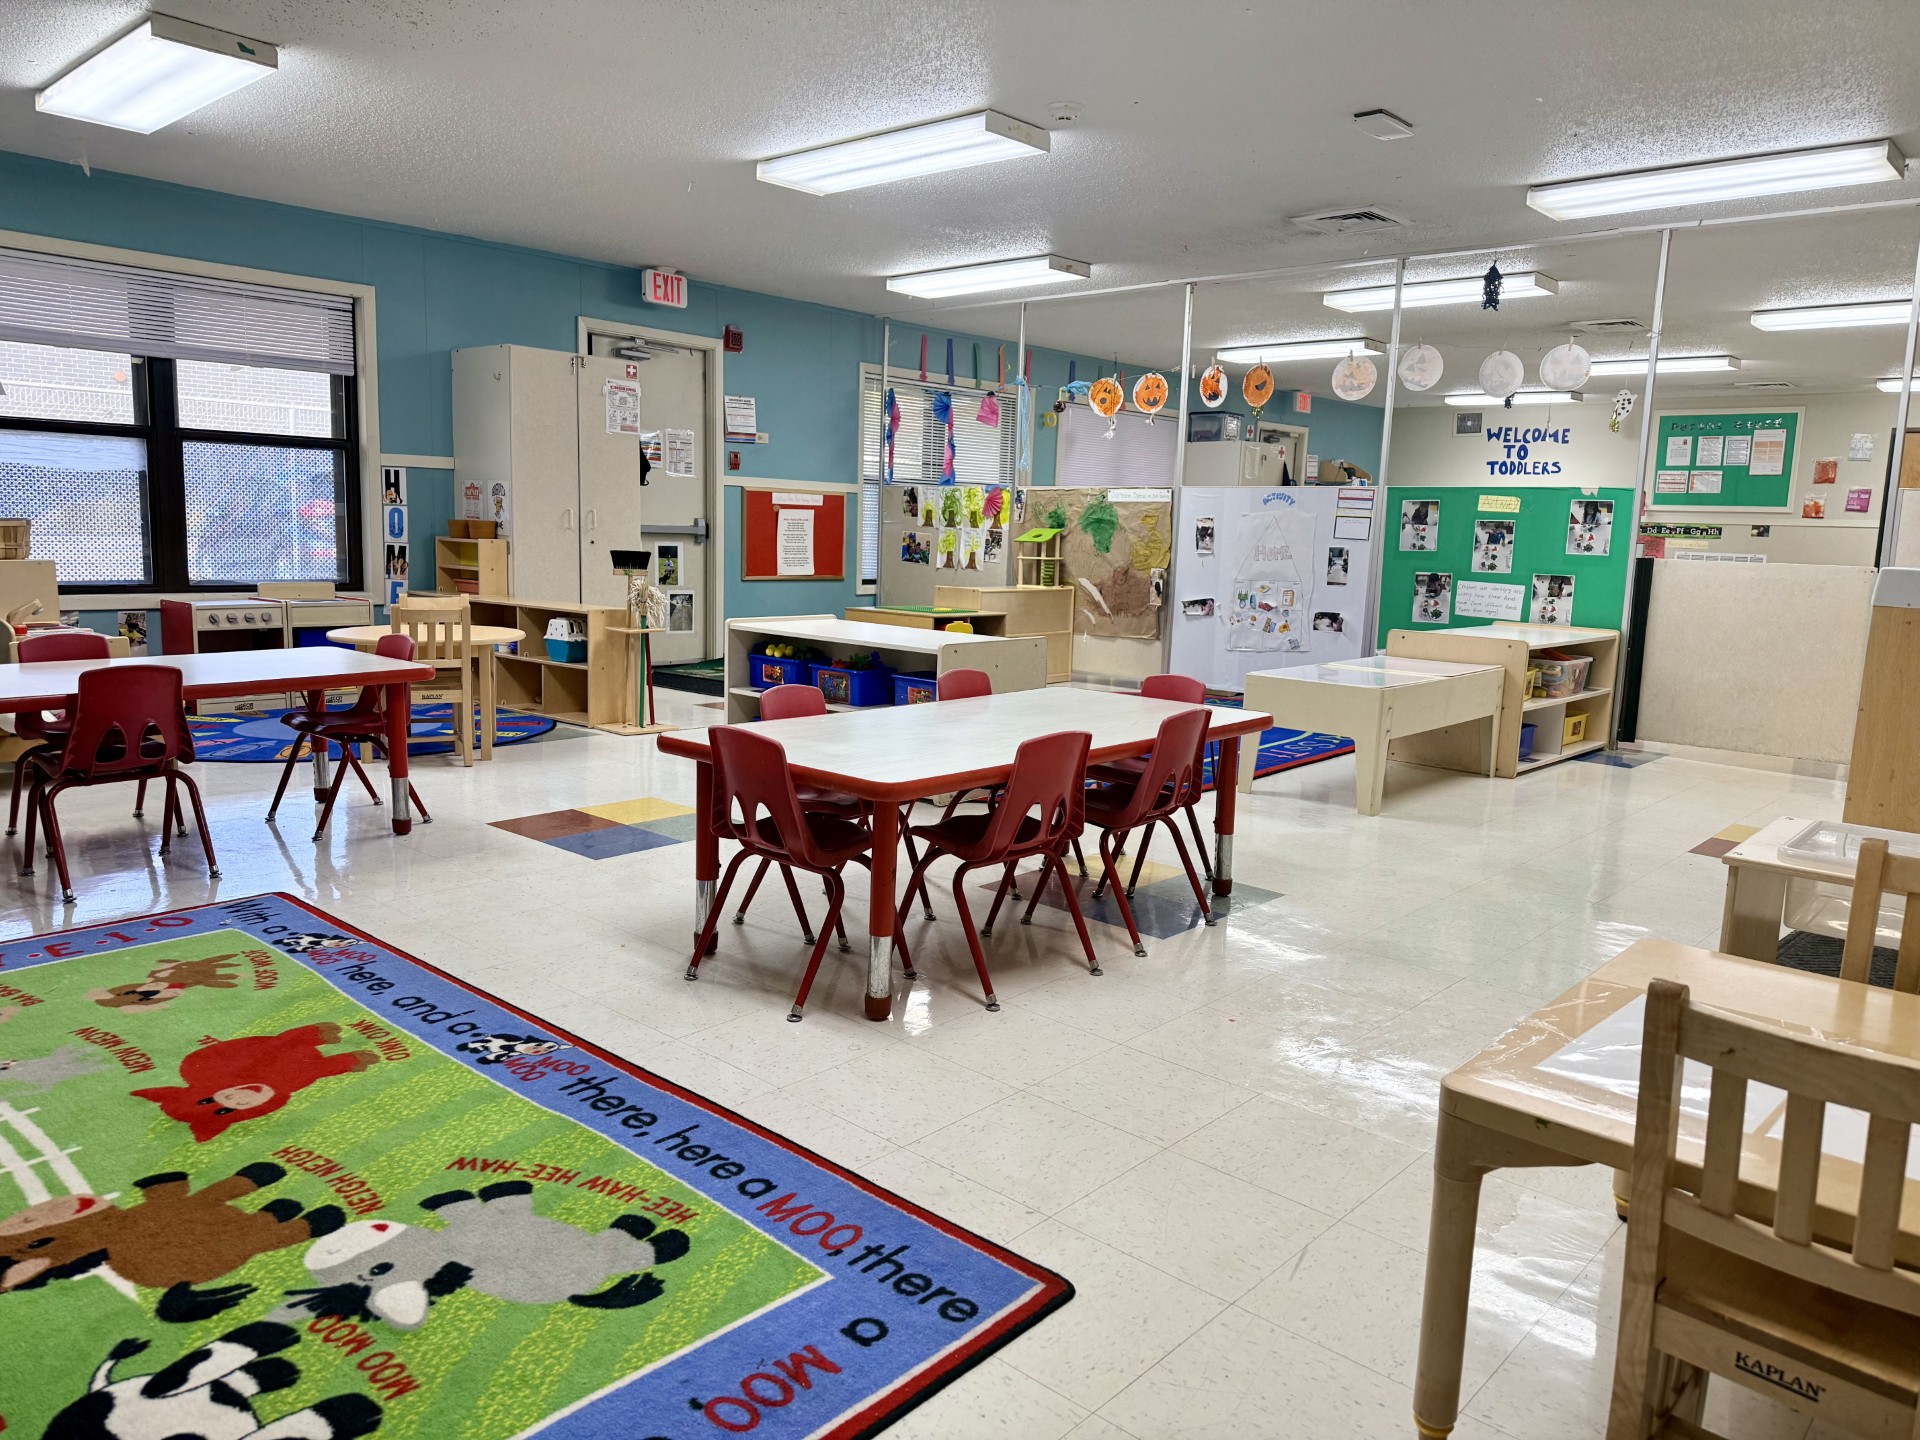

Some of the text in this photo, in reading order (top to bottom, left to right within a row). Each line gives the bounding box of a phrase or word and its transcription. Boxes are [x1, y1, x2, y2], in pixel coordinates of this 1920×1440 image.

[653, 271, 683, 305] EXIT
[1486, 426, 1570, 444] WELCOME
[1503, 444, 1529, 460] TO
[1486, 461, 1562, 475] TODDLERS
[1262, 492, 1296, 506] ACTIVITY
[219, 899, 281, 925] With
[262, 925, 291, 934] a
[335, 961, 395, 996] here,
[391, 996, 476, 1024] and
[348, 1019, 411, 1062] OINK OINK
[447, 1022, 482, 1036] a
[68, 1026, 157, 1074] MEOW MEOW
[502, 1057, 547, 1082] MOO
[532, 1056, 590, 1076] MOO
[558, 1076, 658, 1138] there,
[653, 1124, 746, 1180] here
[271, 1145, 386, 1216] NEIGH NEIGH
[445, 1157, 699, 1224] HEE-HAW HEE-HAW
[737, 1178, 778, 1200] a
[848, 1244, 979, 1323] there
[840, 1317, 889, 1347] a
[308, 1314, 422, 1402] MOO MOO
[1735, 1351, 1821, 1398] KAPLAN
